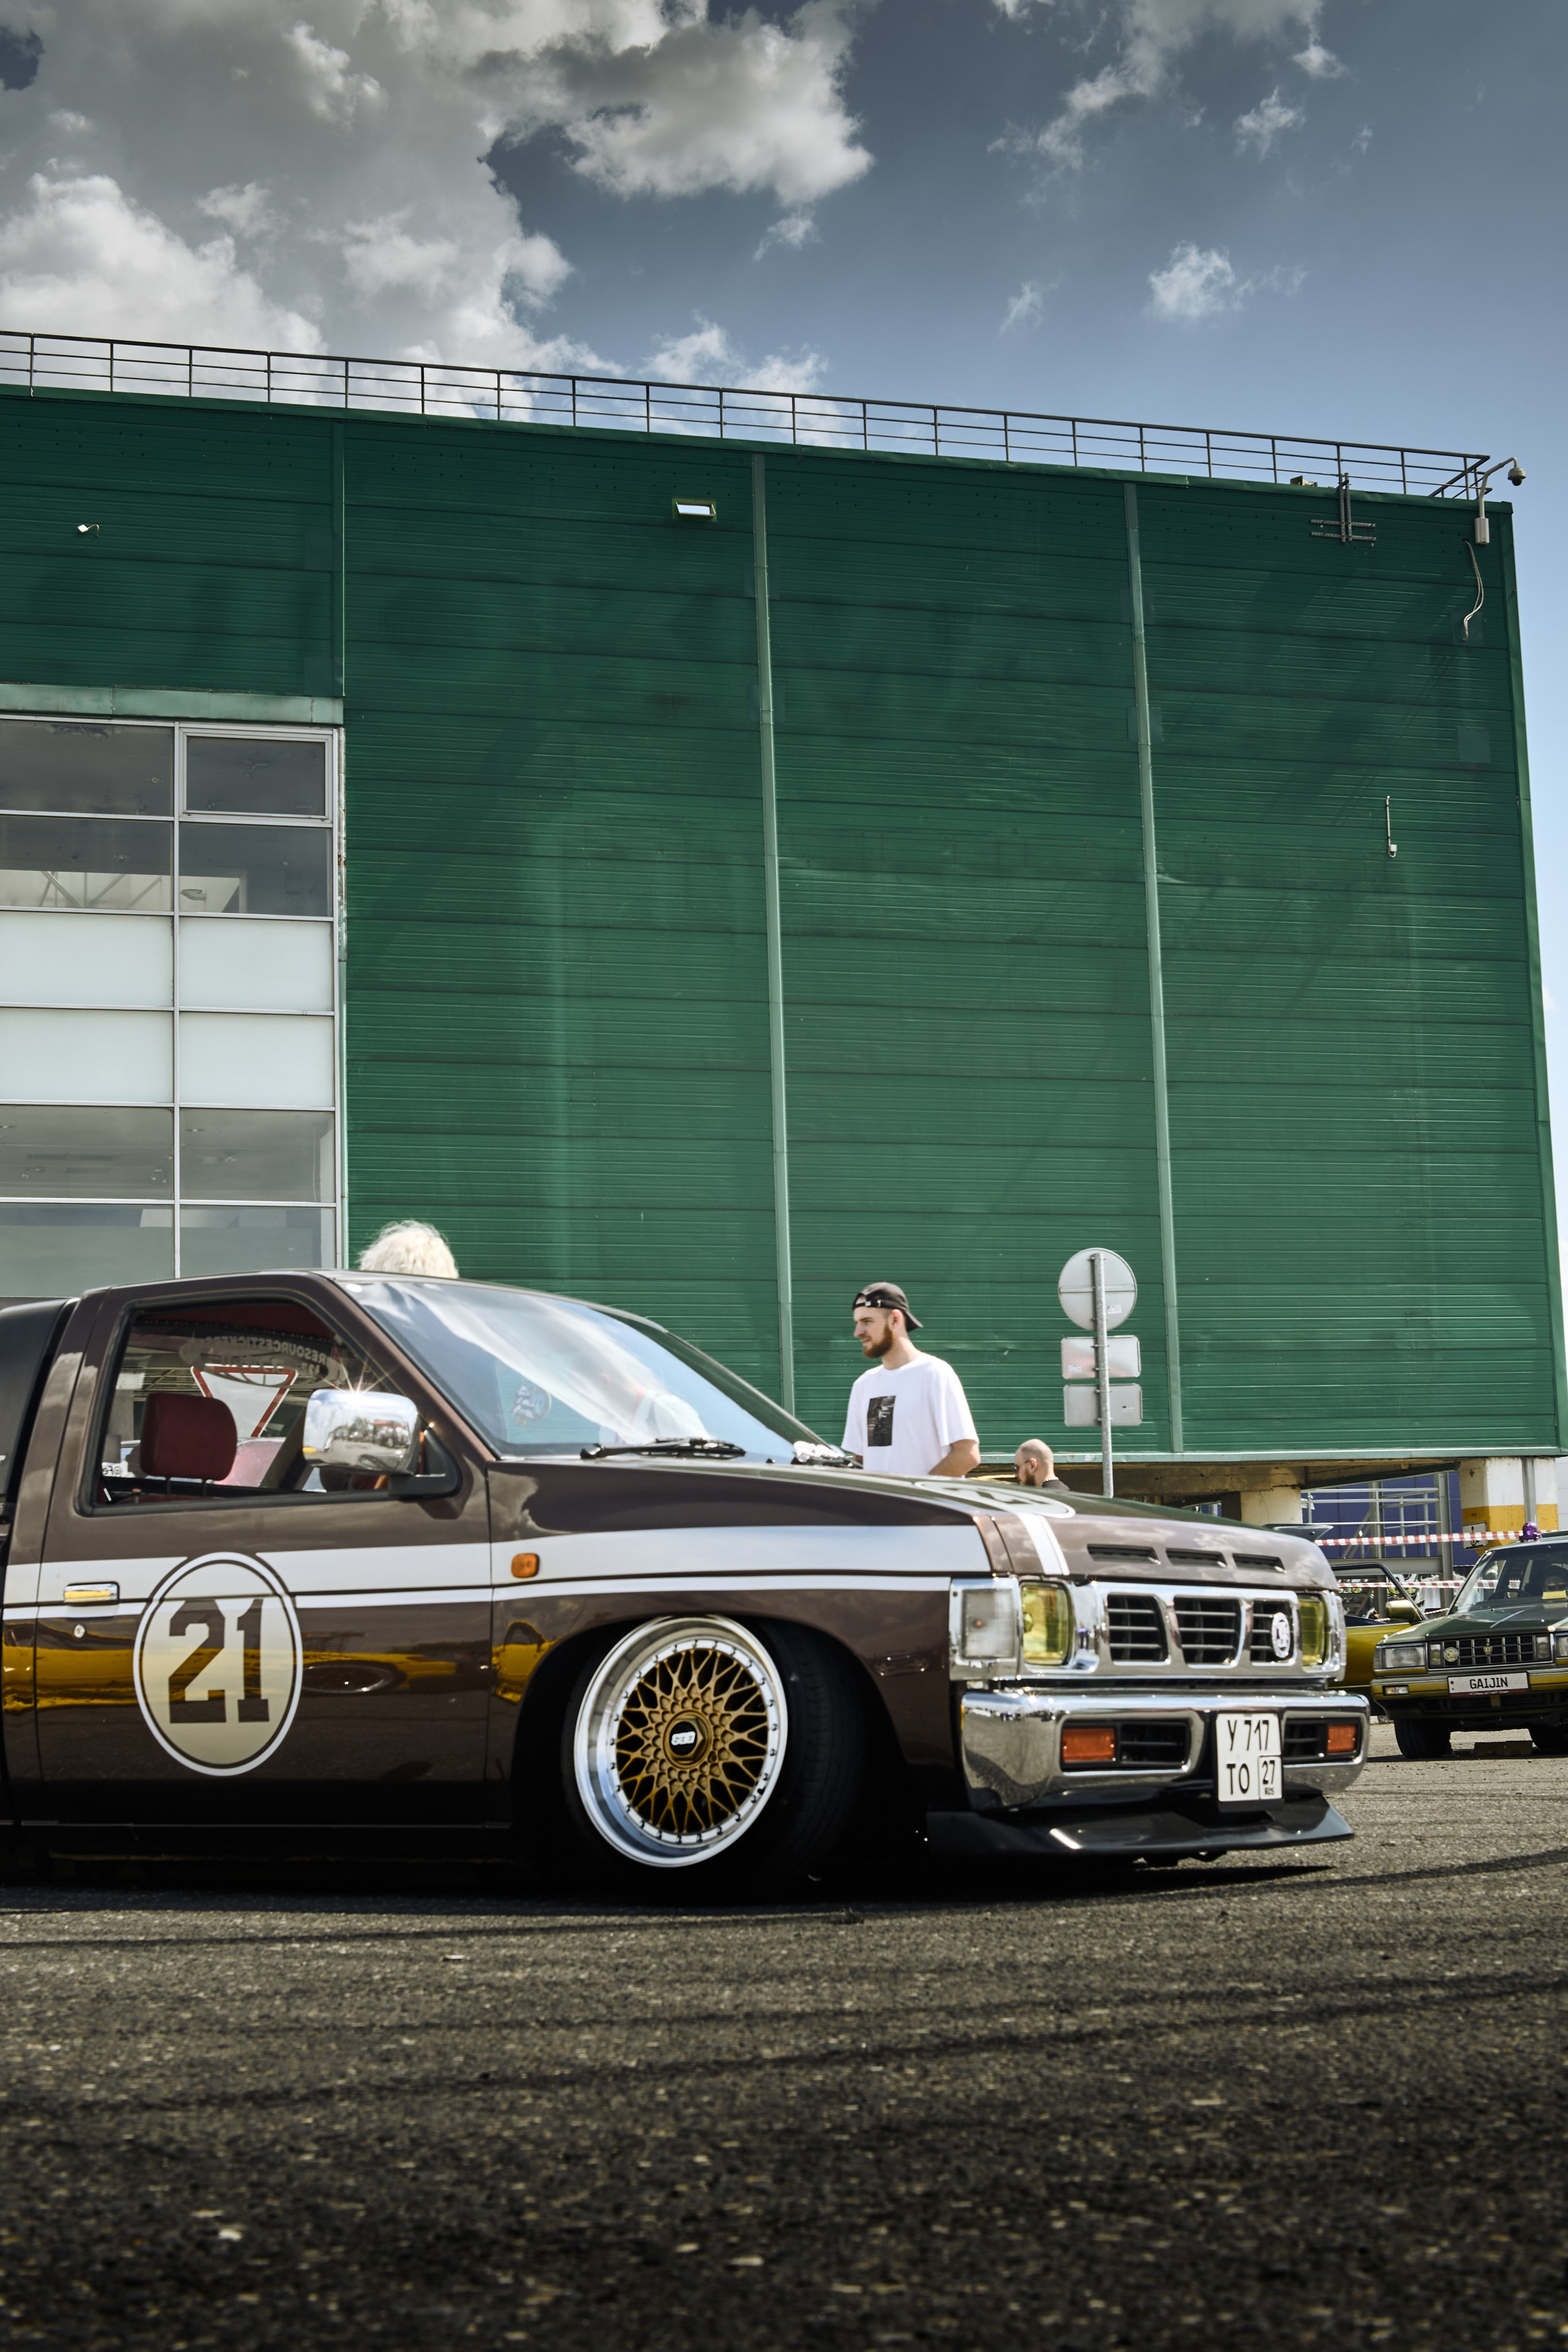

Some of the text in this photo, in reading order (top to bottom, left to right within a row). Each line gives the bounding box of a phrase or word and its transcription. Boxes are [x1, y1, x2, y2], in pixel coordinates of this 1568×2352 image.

[168, 1599, 270, 1723] 21
[1469, 1677, 1508, 1689] GAIJIN
[1244, 1720, 1269, 1751] 717
[1262, 1760, 1275, 1785] 27
[1264, 1787, 1275, 1796] RUS
